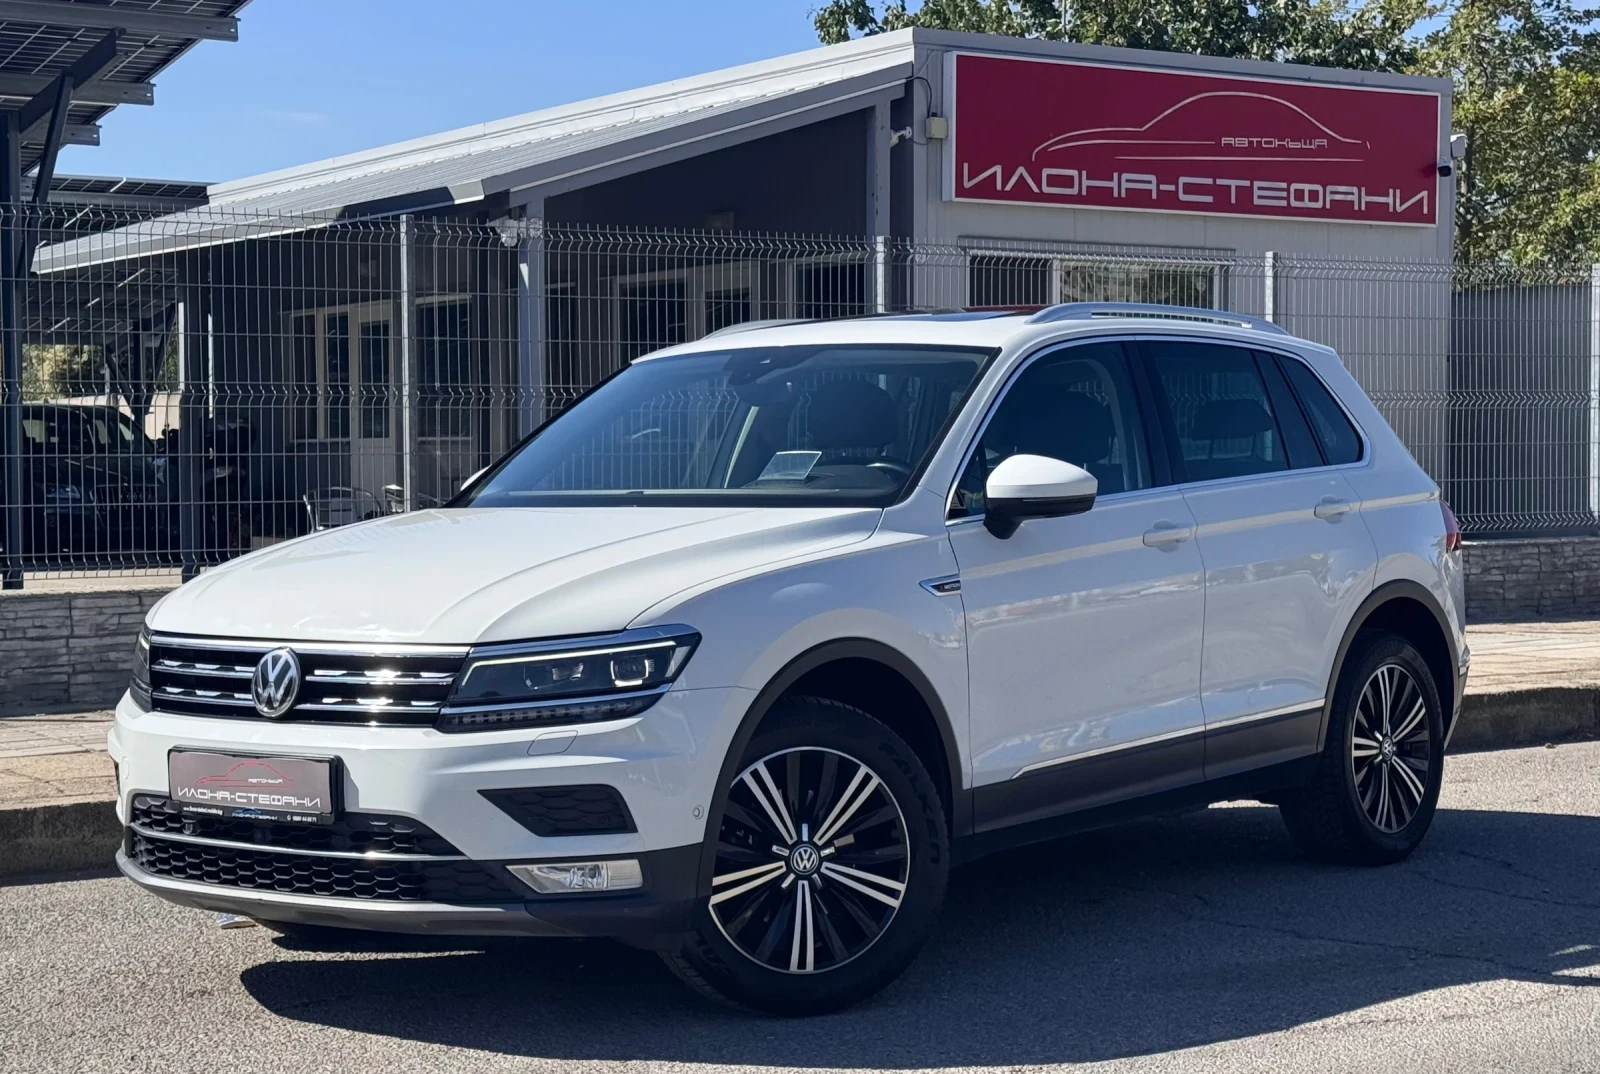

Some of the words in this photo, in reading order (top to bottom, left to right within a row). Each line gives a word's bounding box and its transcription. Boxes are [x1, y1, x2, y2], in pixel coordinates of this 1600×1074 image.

[1221, 136, 1328, 150] АВТОКЪЩА
[963, 161, 1430, 215] ИЛОНА-СТЕФАНИ
[177, 786, 321, 808] ИЛОНА-СТЕФАНИ
